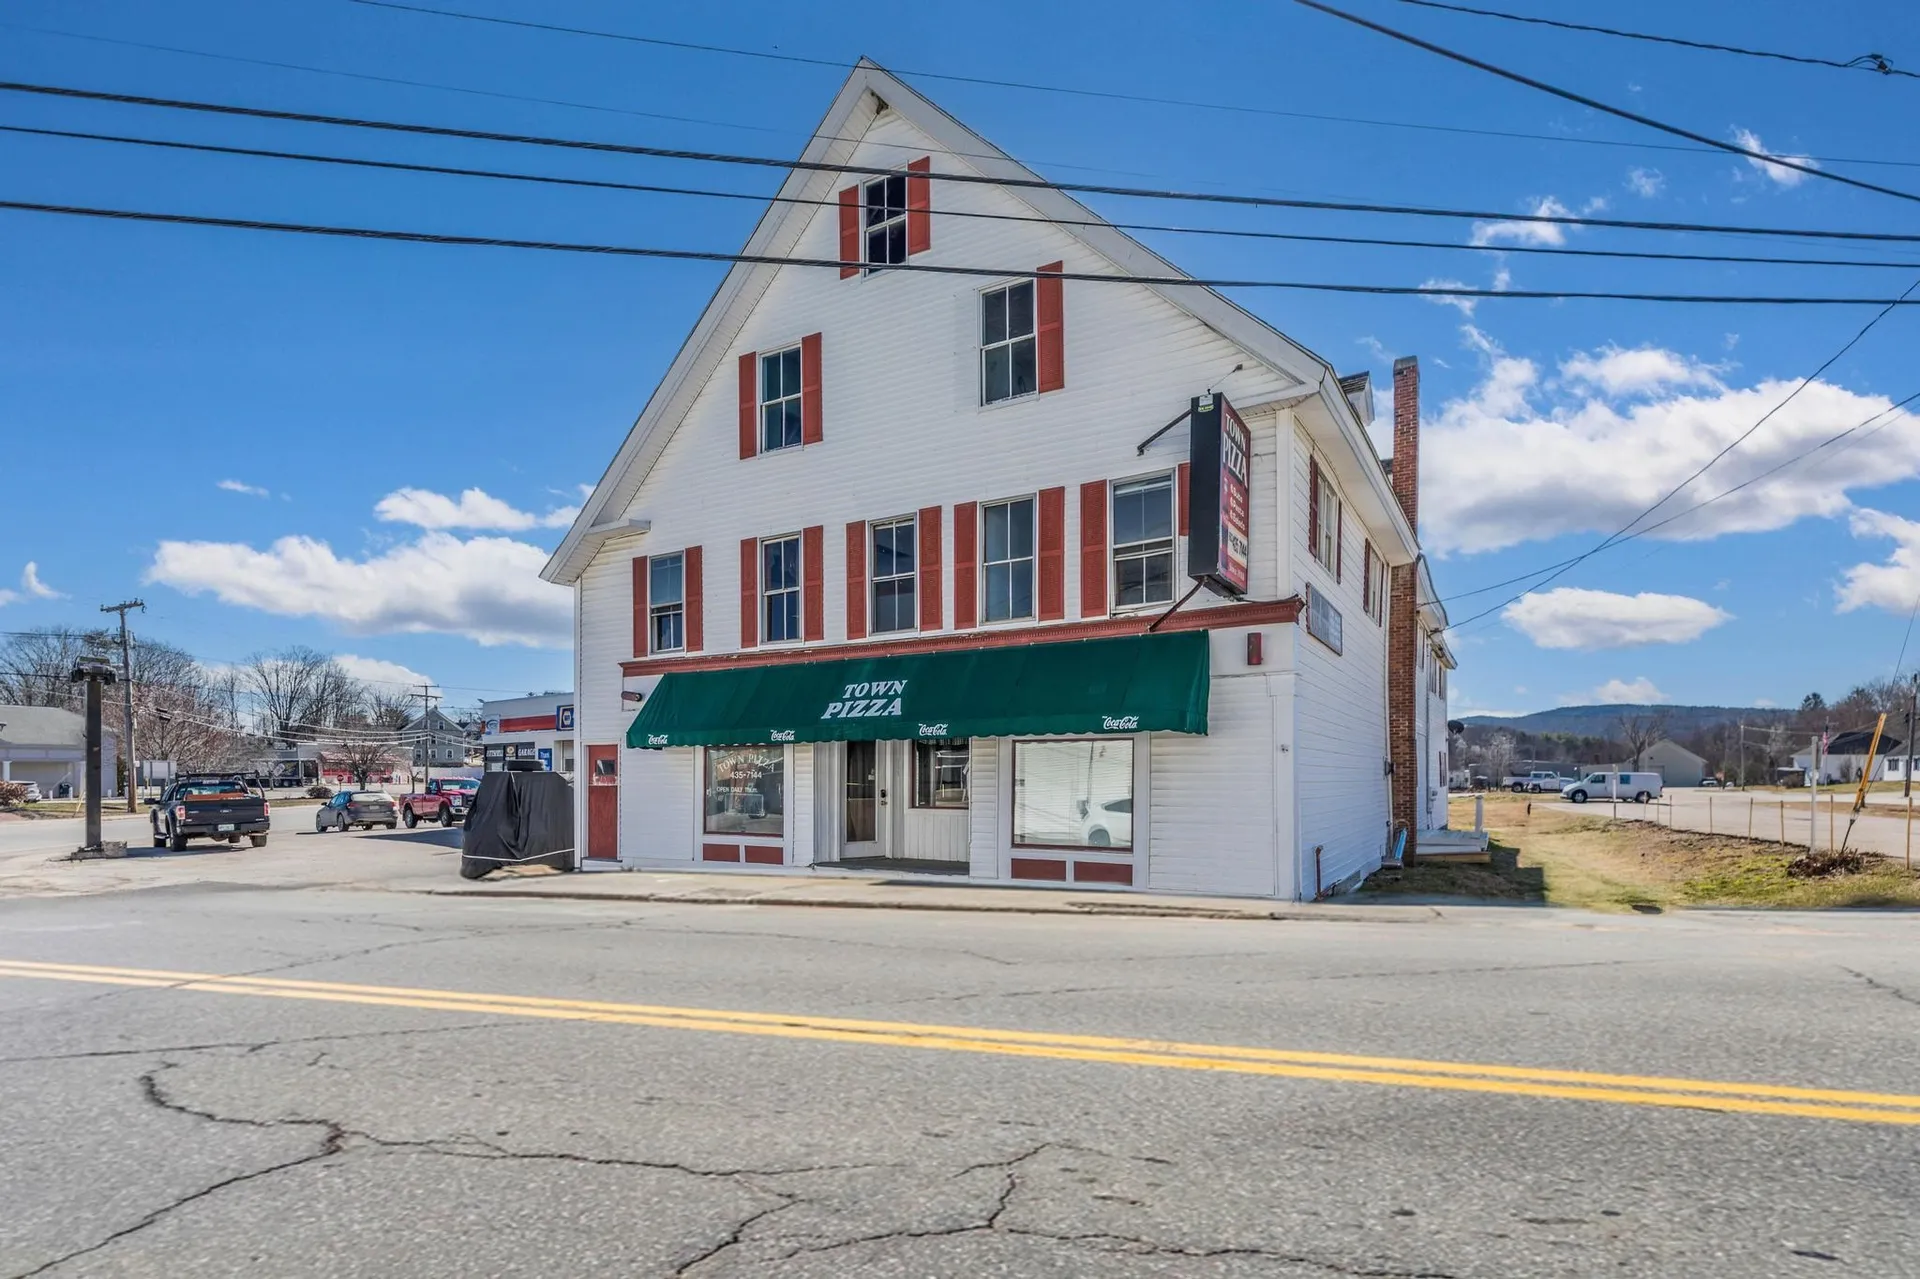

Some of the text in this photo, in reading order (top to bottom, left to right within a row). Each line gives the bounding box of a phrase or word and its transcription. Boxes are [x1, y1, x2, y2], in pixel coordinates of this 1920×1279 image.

[1225, 413, 1246, 452] TOWN
[1223, 431, 1248, 489] PIZZA
[842, 680, 908, 699] TOWN
[820, 698, 902, 720] PIZZA
[717, 753, 775, 773] TOWN PIZZA
[729, 769, 763, 779] 435-7144
